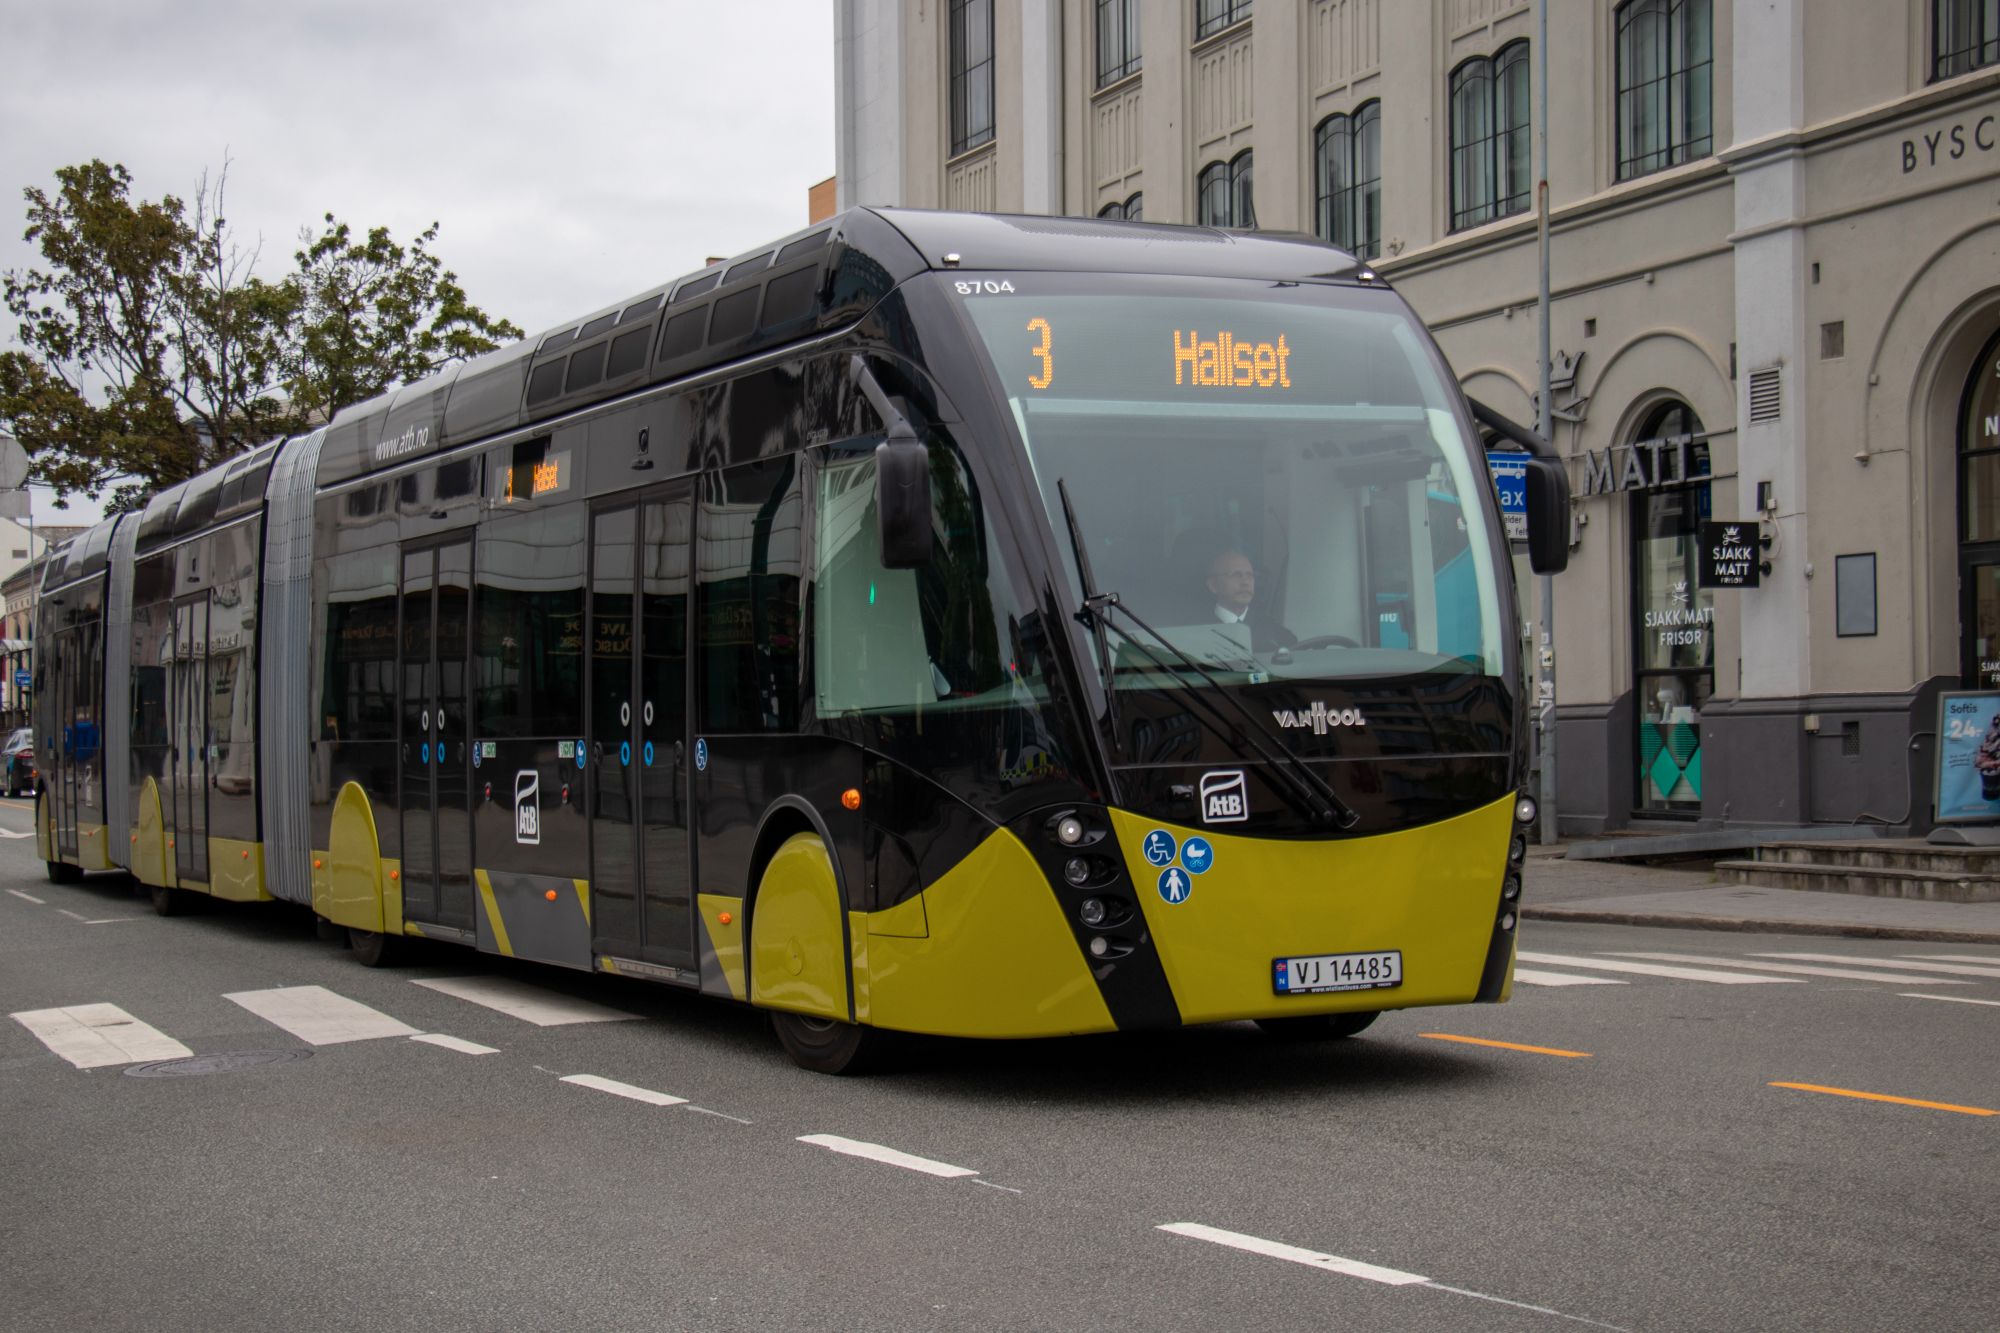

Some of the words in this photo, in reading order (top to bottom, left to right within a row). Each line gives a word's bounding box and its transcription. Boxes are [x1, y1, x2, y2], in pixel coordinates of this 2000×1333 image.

[1902, 115, 1995, 174] BYSC
[954, 281, 1016, 295] 8704
[1027, 318, 1053, 389] 3
[1174, 330, 1291, 388] Hallset
[375, 424, 429, 461] www.atb.no
[1582, 433, 1693, 497] MATT
[1712, 547, 1752, 560] SJAKK
[1714, 563, 1749, 576] MATT
[1644, 611, 1681, 627] SJAKK
[1659, 630, 1702, 646] FRISØR
[1950, 704, 1978, 714] Softis
[1208, 795, 1242, 817] AtB
[519, 805, 537, 835] AtB
[1296, 961, 1320, 985] VJ
[1330, 956, 1393, 982] 14485
